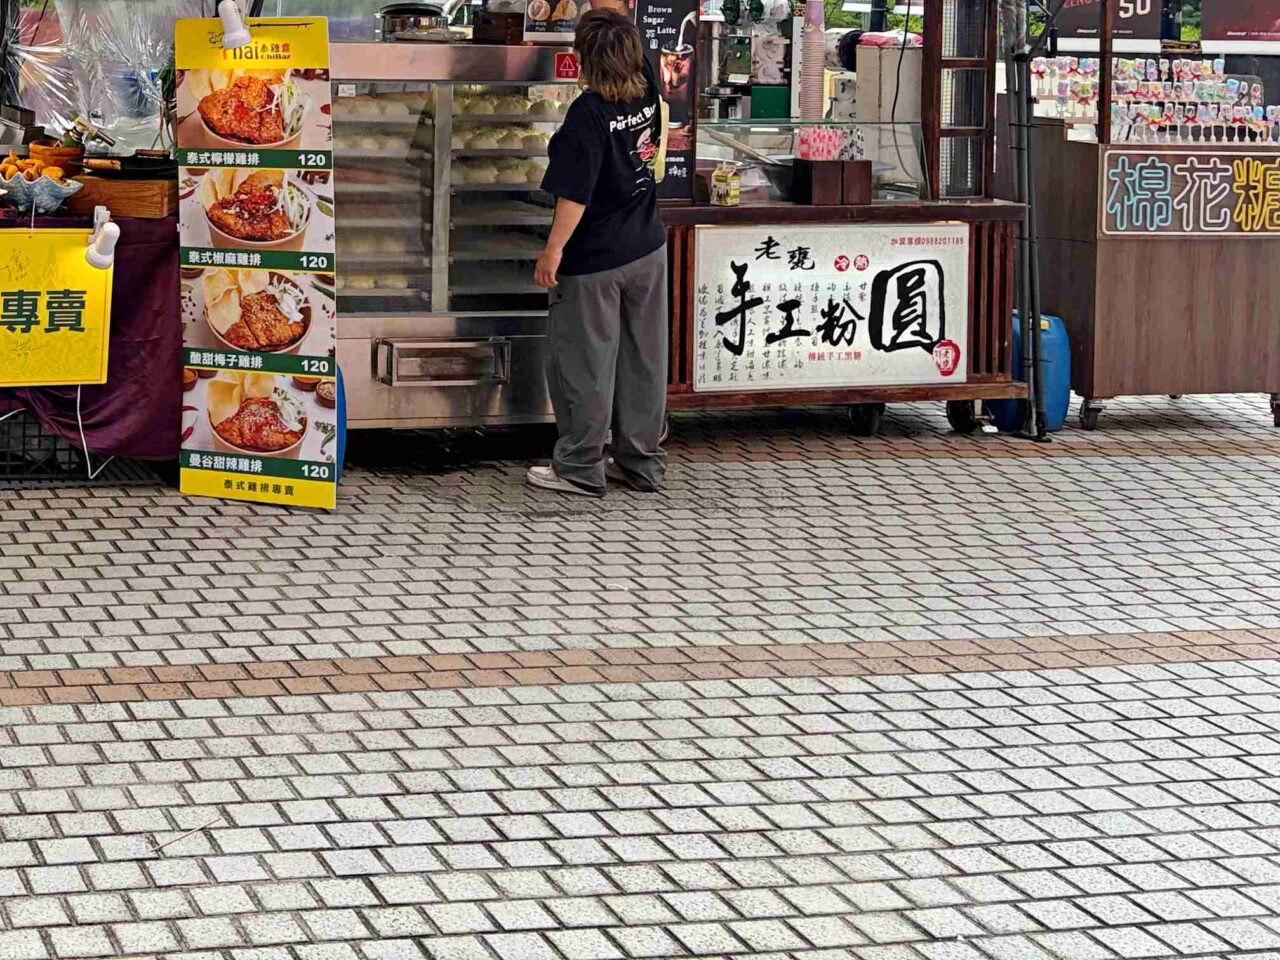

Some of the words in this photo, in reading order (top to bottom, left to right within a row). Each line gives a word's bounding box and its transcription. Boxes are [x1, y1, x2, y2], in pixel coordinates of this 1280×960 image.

[643, 16, 665, 25] Sugar
[609, 112, 643, 133] Perfect
[186, 151, 260, 166] 泰式檸檬雞排
[298, 153, 326, 166] 120
[1107, 156, 1280, 232] 棉花糖
[188, 250, 262, 266] 泰式椒麻雞排
[300, 255, 328, 268] 120
[754, 236, 816, 271] 老甕
[715, 258, 947, 356] 手工粉圓
[189, 350, 263, 369] 酸甜梅子雞排
[301, 359, 329, 373] 120
[189, 453, 263, 473] 曼谷甜辣雞排
[301, 465, 329, 479] 120
[223, 478, 295, 496] 泰式雞排專賣
